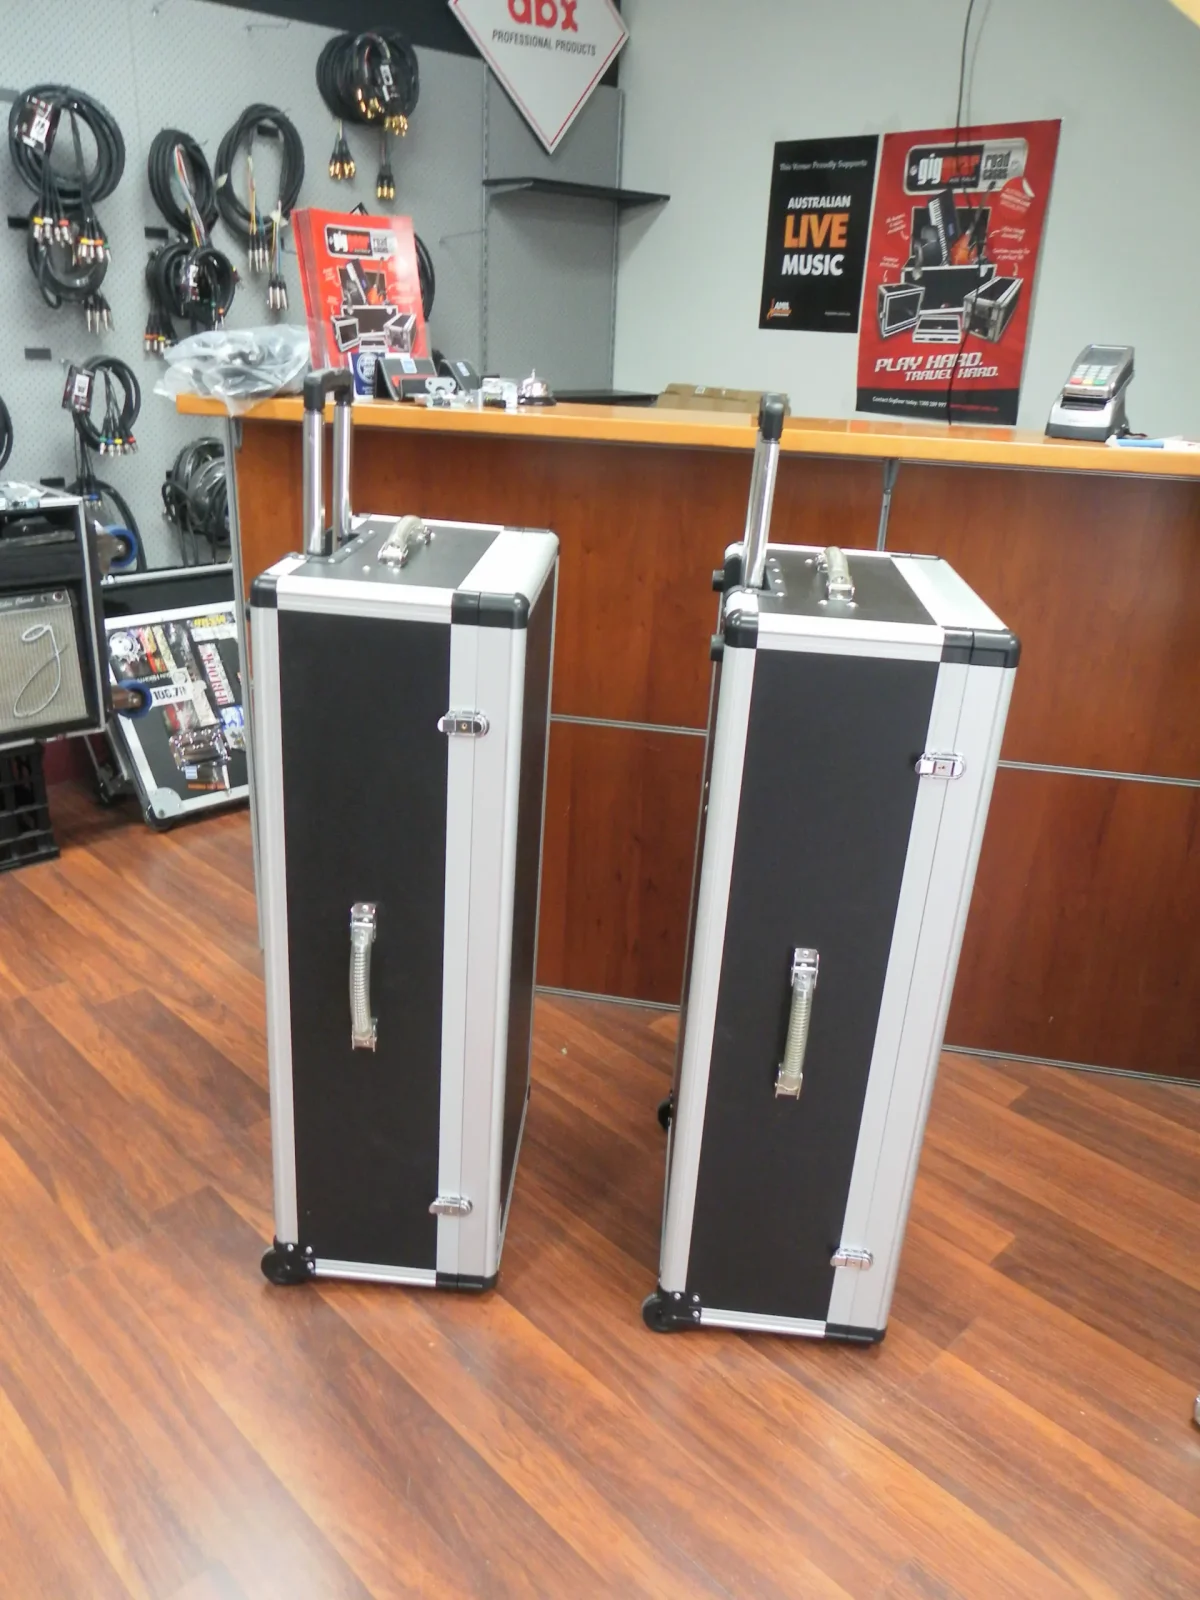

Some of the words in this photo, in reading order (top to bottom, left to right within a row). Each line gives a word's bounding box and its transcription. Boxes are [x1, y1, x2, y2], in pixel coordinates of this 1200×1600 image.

[492, 29, 553, 49] PROFESSIONAL
[555, 39, 597, 56] PRODUCTS
[787, 195, 851, 209] AUSTRALIAN
[783, 213, 849, 248] LIVE
[781, 253, 845, 276] MUSIC
[874, 356, 923, 372] PLAY
[926, 352, 983, 369] HARD.
[905, 369, 952, 381] TRAVEL
[957, 366, 999, 378] HARD.
